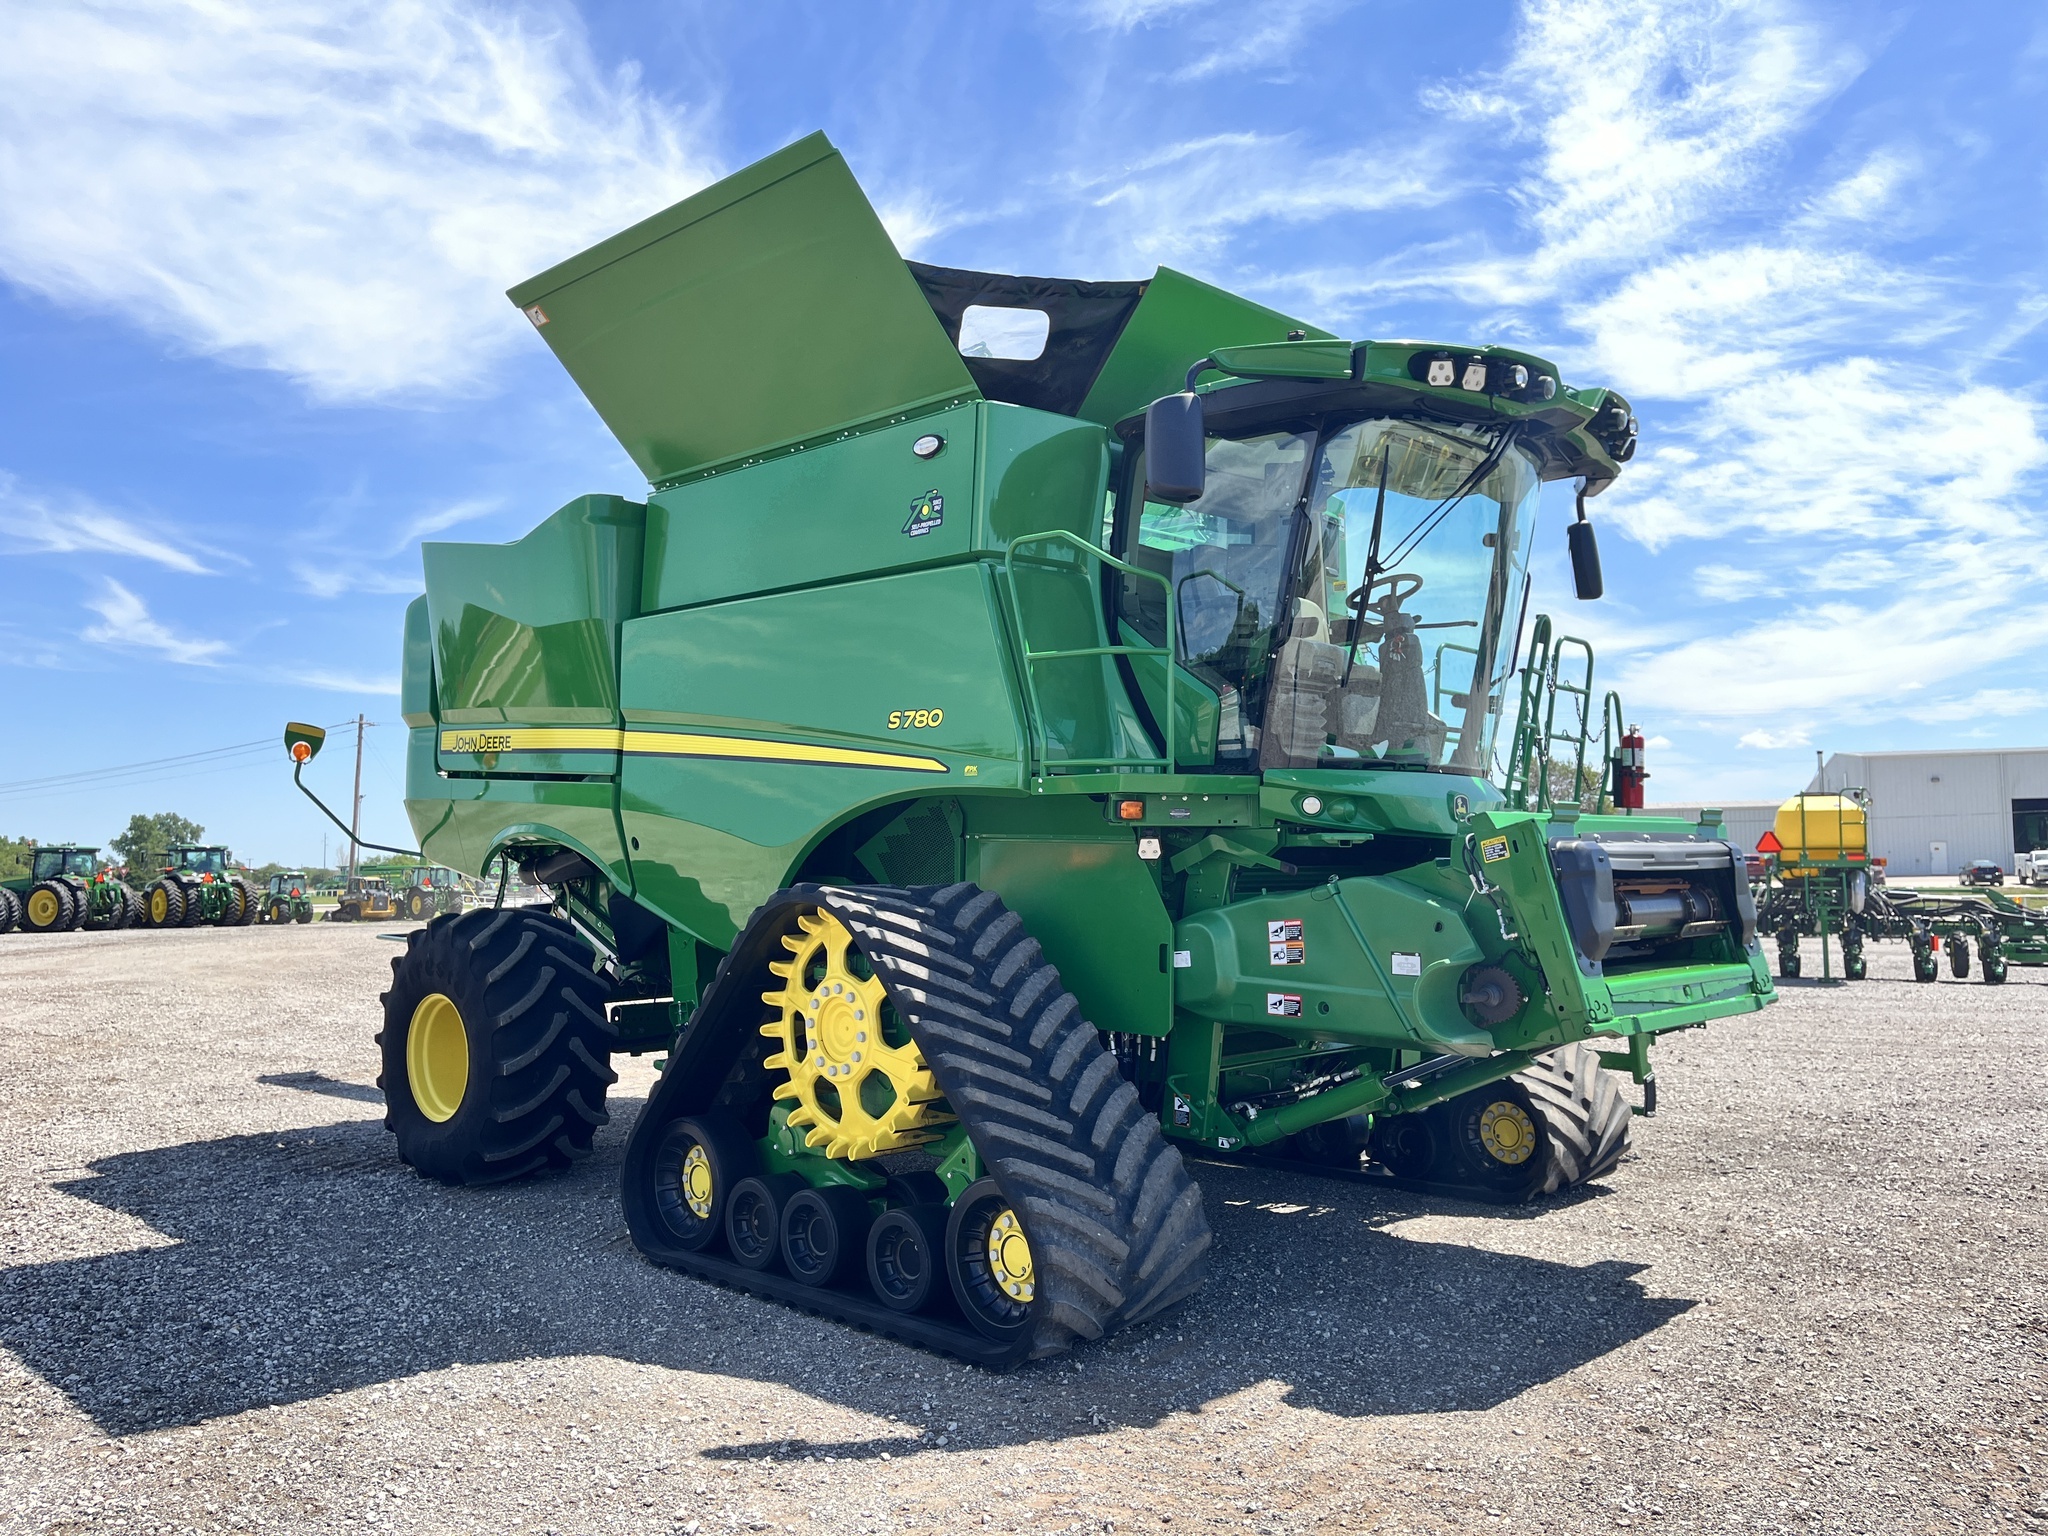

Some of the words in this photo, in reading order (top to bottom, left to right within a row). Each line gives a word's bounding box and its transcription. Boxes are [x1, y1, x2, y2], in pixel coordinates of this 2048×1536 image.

[887, 708, 944, 730] S780
[452, 734, 478, 751] JOHN
[479, 733, 512, 751] DEERE
